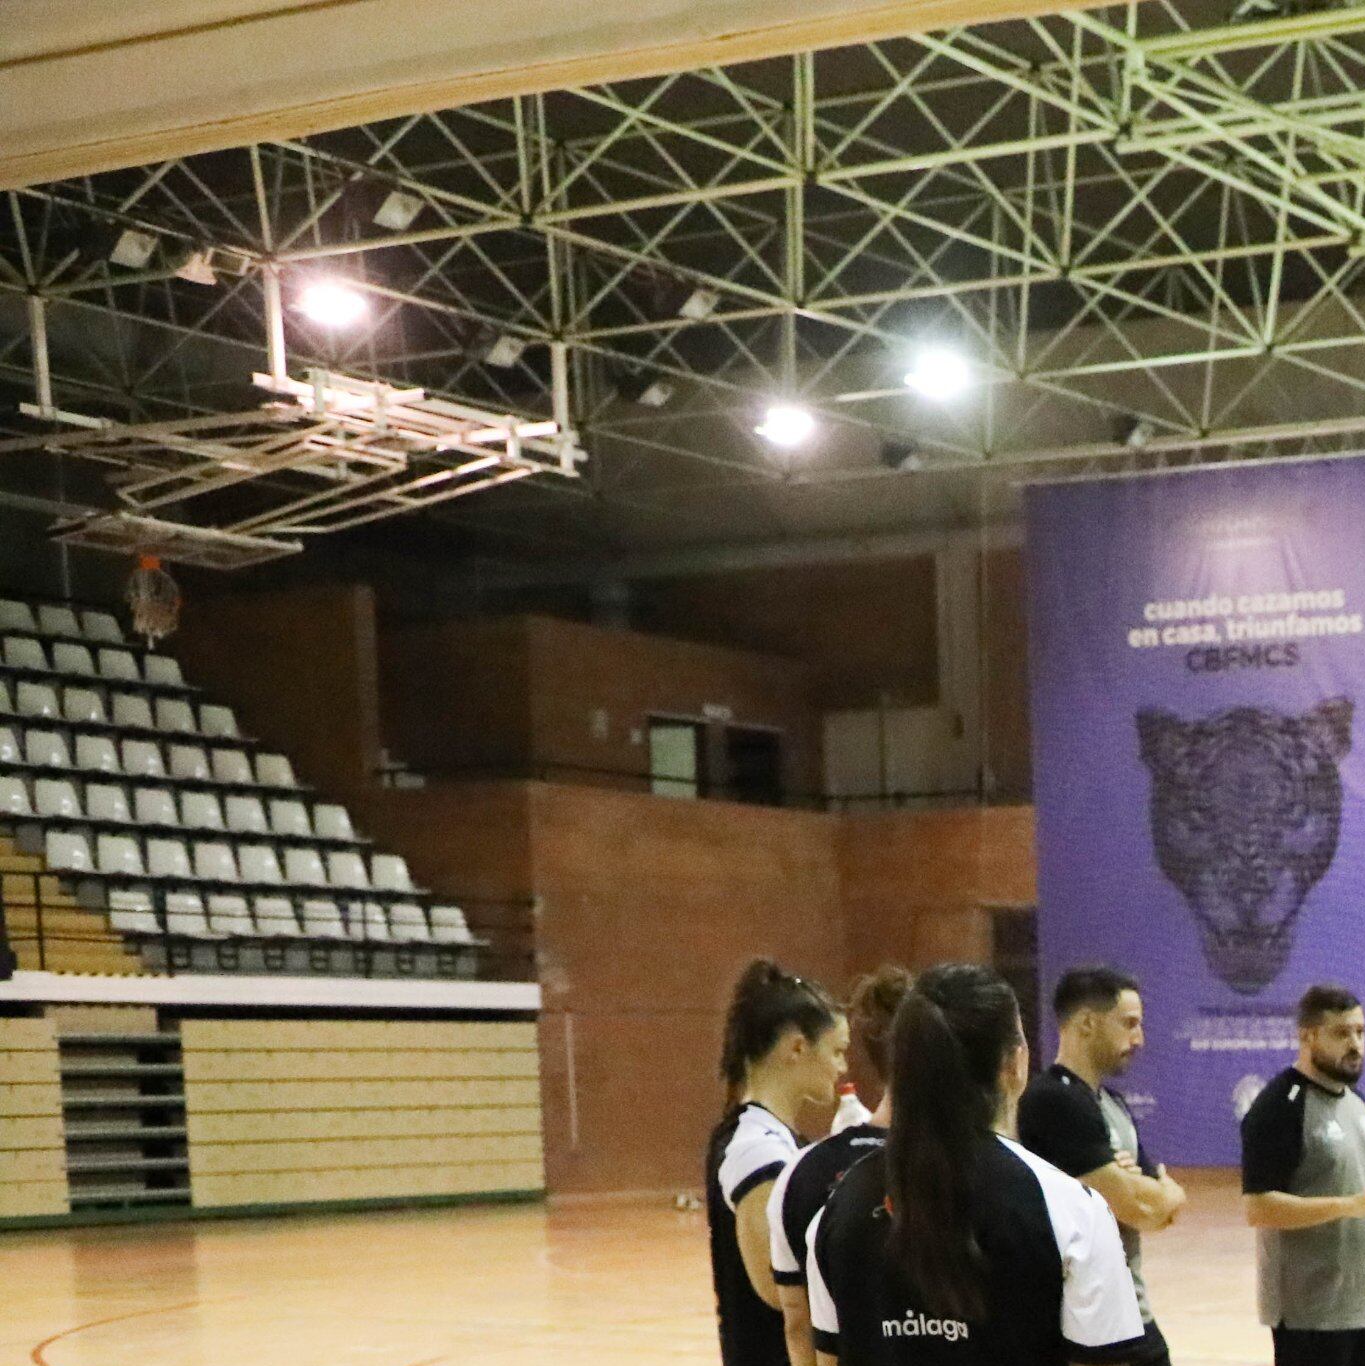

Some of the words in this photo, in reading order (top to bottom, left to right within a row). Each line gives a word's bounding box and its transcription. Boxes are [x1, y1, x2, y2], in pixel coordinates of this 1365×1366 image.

[1144, 593, 1234, 621] cuando
[1236, 589, 1345, 613] cazamos
[1128, 627, 1159, 647] en
[1161, 623, 1222, 645] casa,
[1226, 613, 1363, 641] triunfamos
